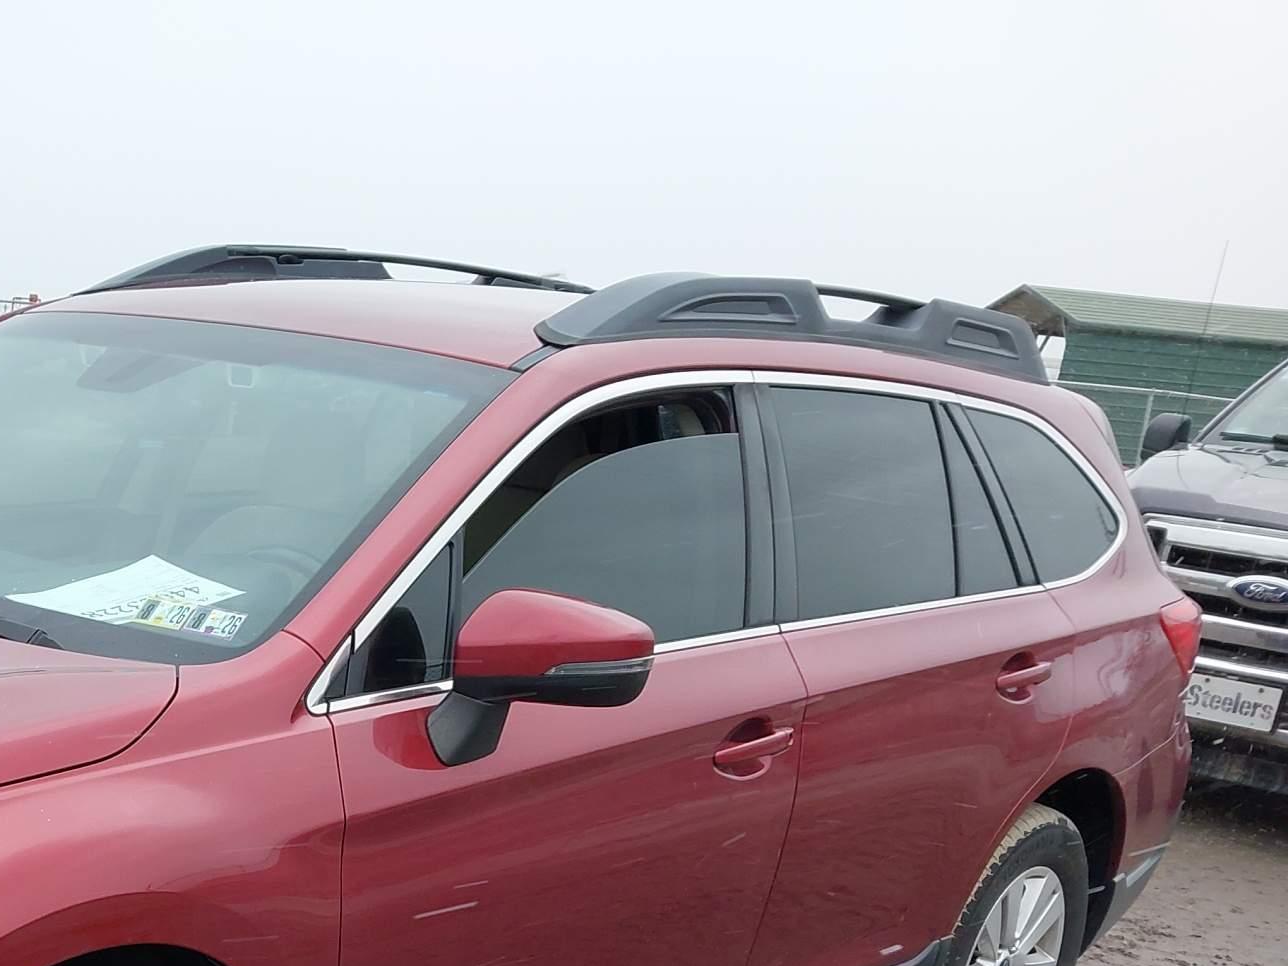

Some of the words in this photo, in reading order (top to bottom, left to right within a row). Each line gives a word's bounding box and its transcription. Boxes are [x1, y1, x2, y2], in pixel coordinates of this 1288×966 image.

[1243, 583, 1286, 602] Ford
[169, 605, 190, 624] 26
[191, 612, 206, 629] 8
[221, 615, 242, 635] 26
[1187, 684, 1274, 720] Steelers
